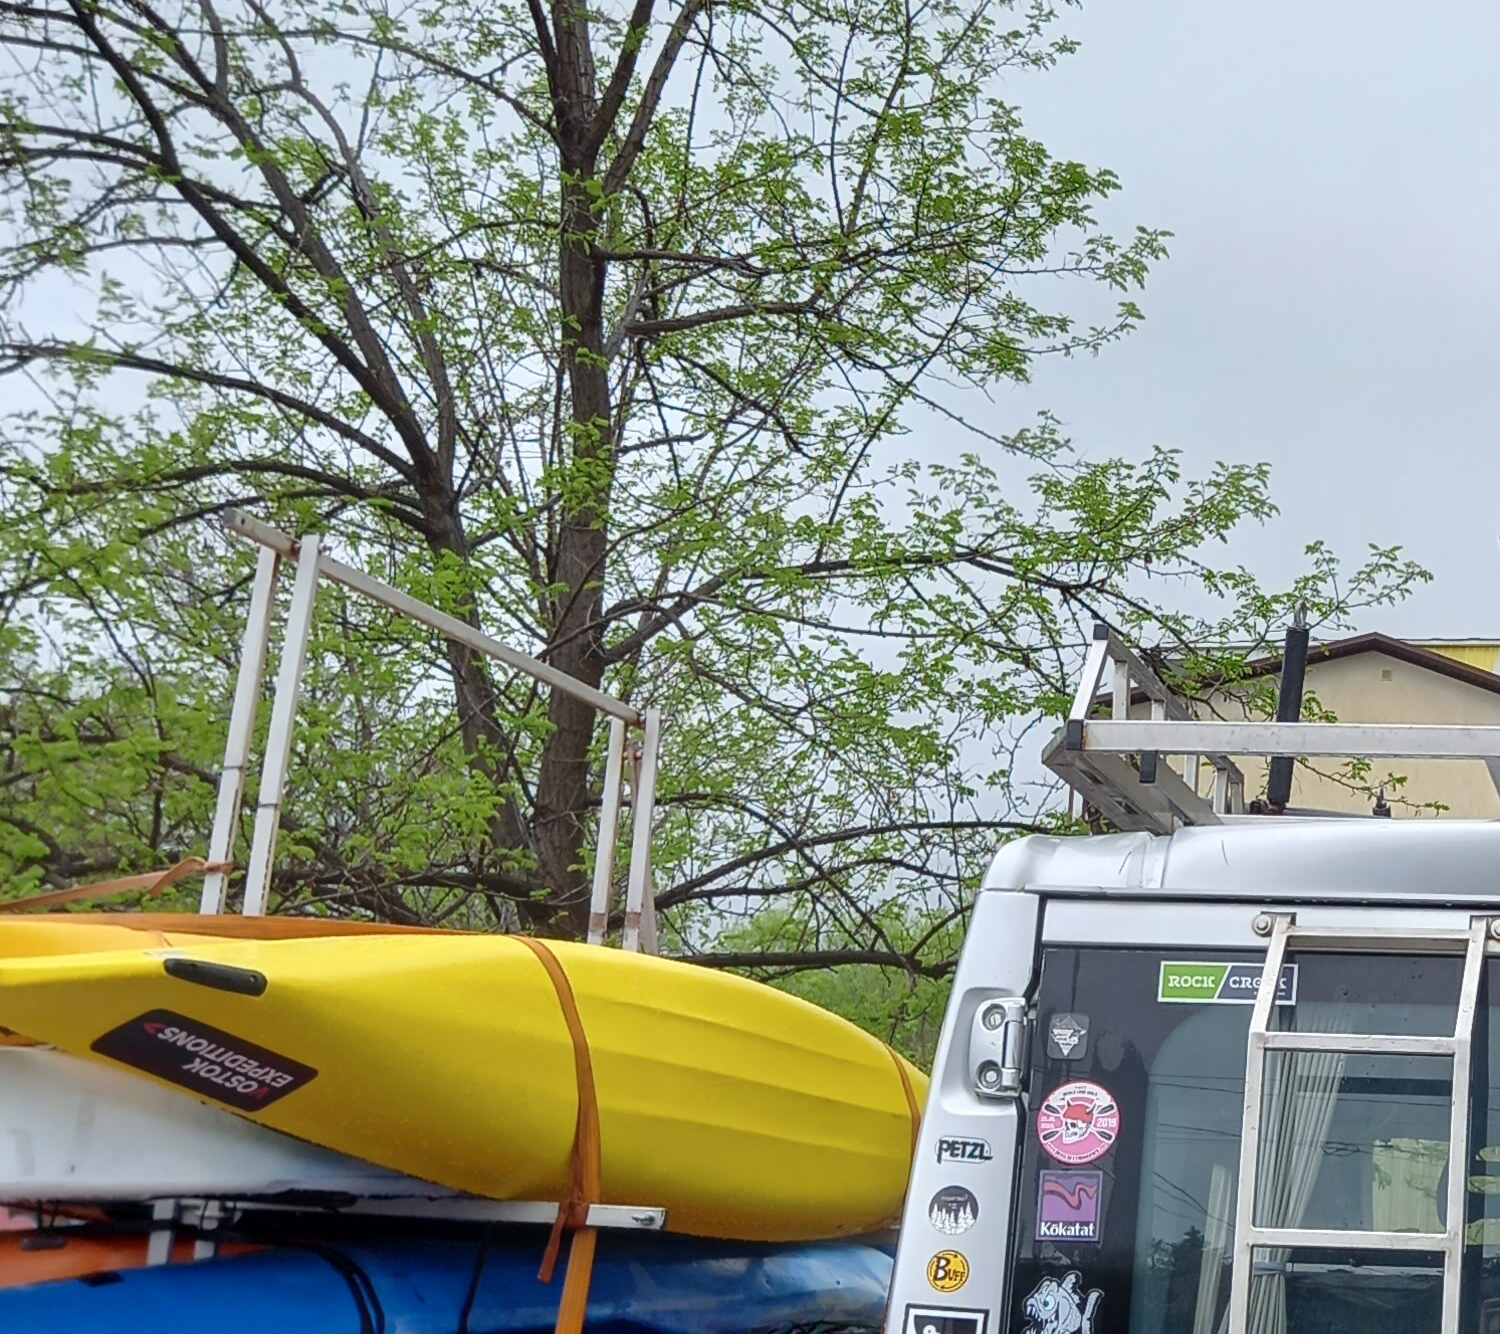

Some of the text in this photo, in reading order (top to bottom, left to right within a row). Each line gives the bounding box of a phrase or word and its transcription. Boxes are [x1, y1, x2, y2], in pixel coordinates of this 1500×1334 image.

[1168, 975, 1287, 989] ROCK CROK
[157, 1026, 293, 1087] EXPEDITIONS
[181, 1057, 269, 1100] VOSTOK
[937, 1139, 993, 1164] PETZL
